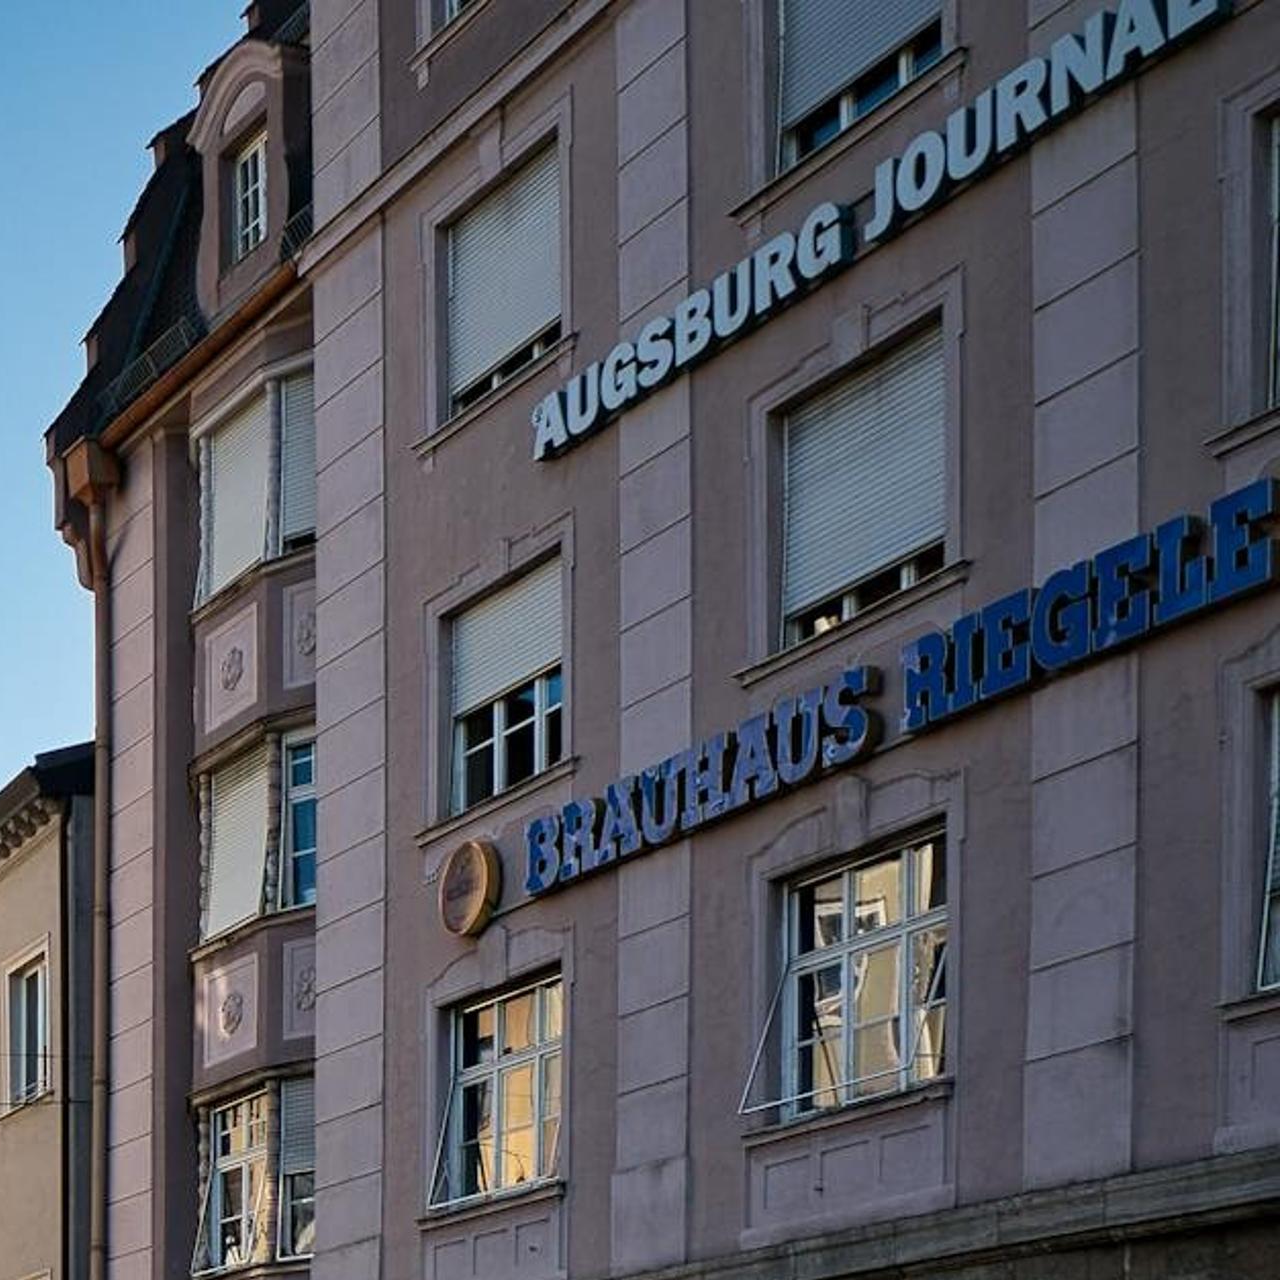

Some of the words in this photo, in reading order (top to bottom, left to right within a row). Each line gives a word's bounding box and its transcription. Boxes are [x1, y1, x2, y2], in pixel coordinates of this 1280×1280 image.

[533, 201, 845, 460] AUGSBURG
[525, 665, 880, 896] BRAUHAUS
[901, 476, 1275, 734] RIEGELE
